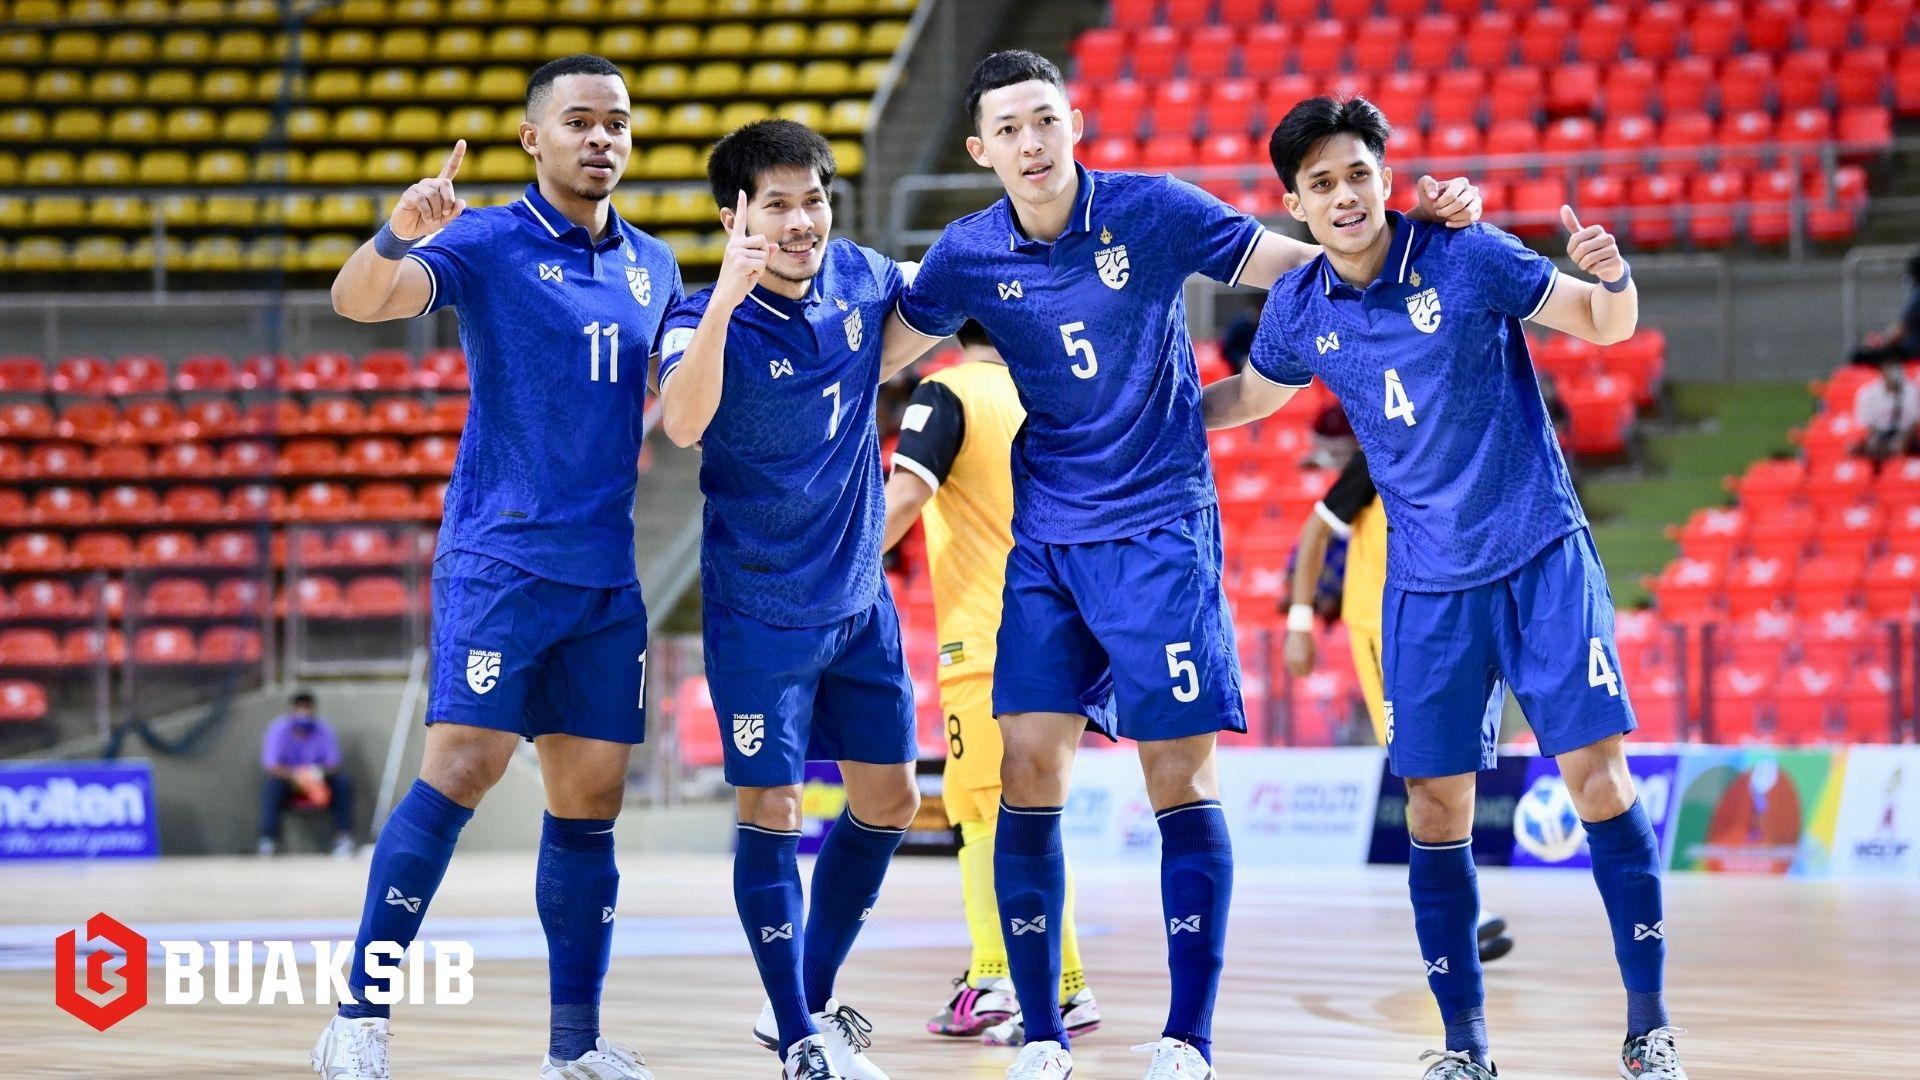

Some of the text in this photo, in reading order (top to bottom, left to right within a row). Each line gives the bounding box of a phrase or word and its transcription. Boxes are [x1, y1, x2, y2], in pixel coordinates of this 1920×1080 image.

[583, 321, 619, 383] 11
[1058, 321, 1098, 380] 5
[822, 381, 841, 440] 7
[1384, 369, 1415, 427] 4
[1165, 641, 1200, 703] 5
[1588, 636, 1620, 697] 4
[948, 714, 964, 759] 8
